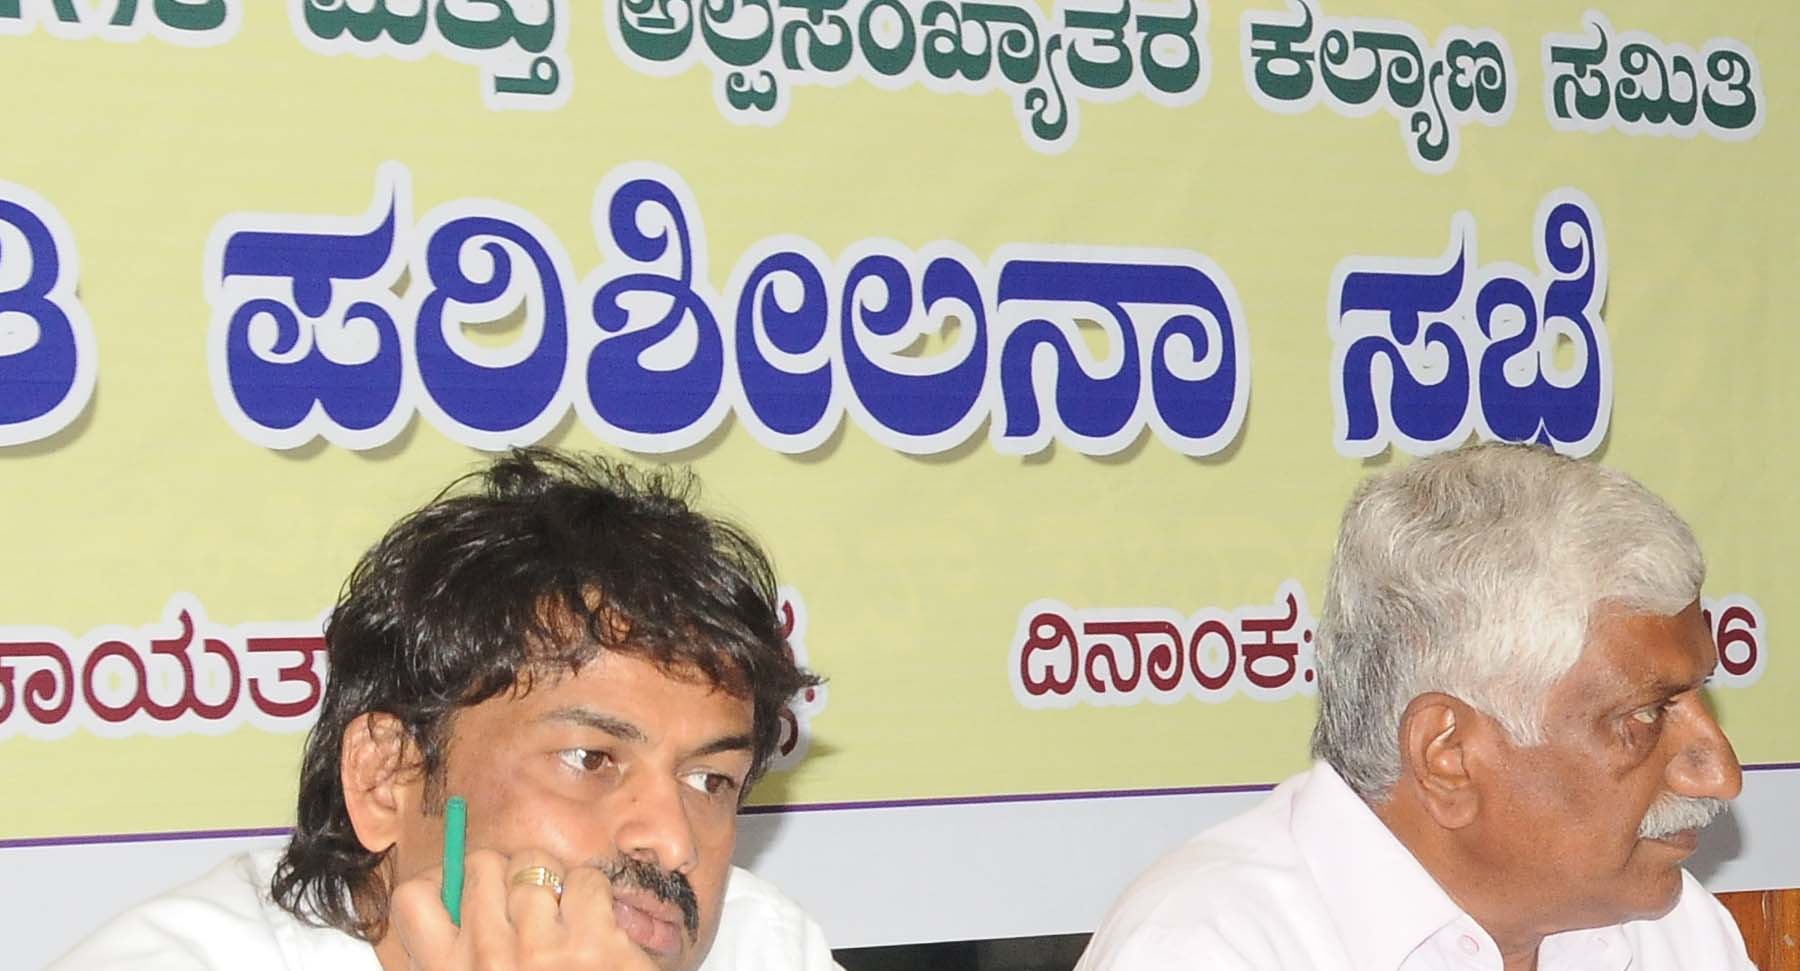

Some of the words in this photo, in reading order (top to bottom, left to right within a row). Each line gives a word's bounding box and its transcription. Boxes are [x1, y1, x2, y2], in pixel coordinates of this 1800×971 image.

[1250, 3, 1508, 162] ಕಲ್ಯಾಣ
[1550, 21, 1758, 130] ಸಮಿತಿ
[221, 177, 1238, 438] ಪರಿಶೀಲನಾ
[1020, 591, 1315, 696] ದಿನಾಂಕ:
